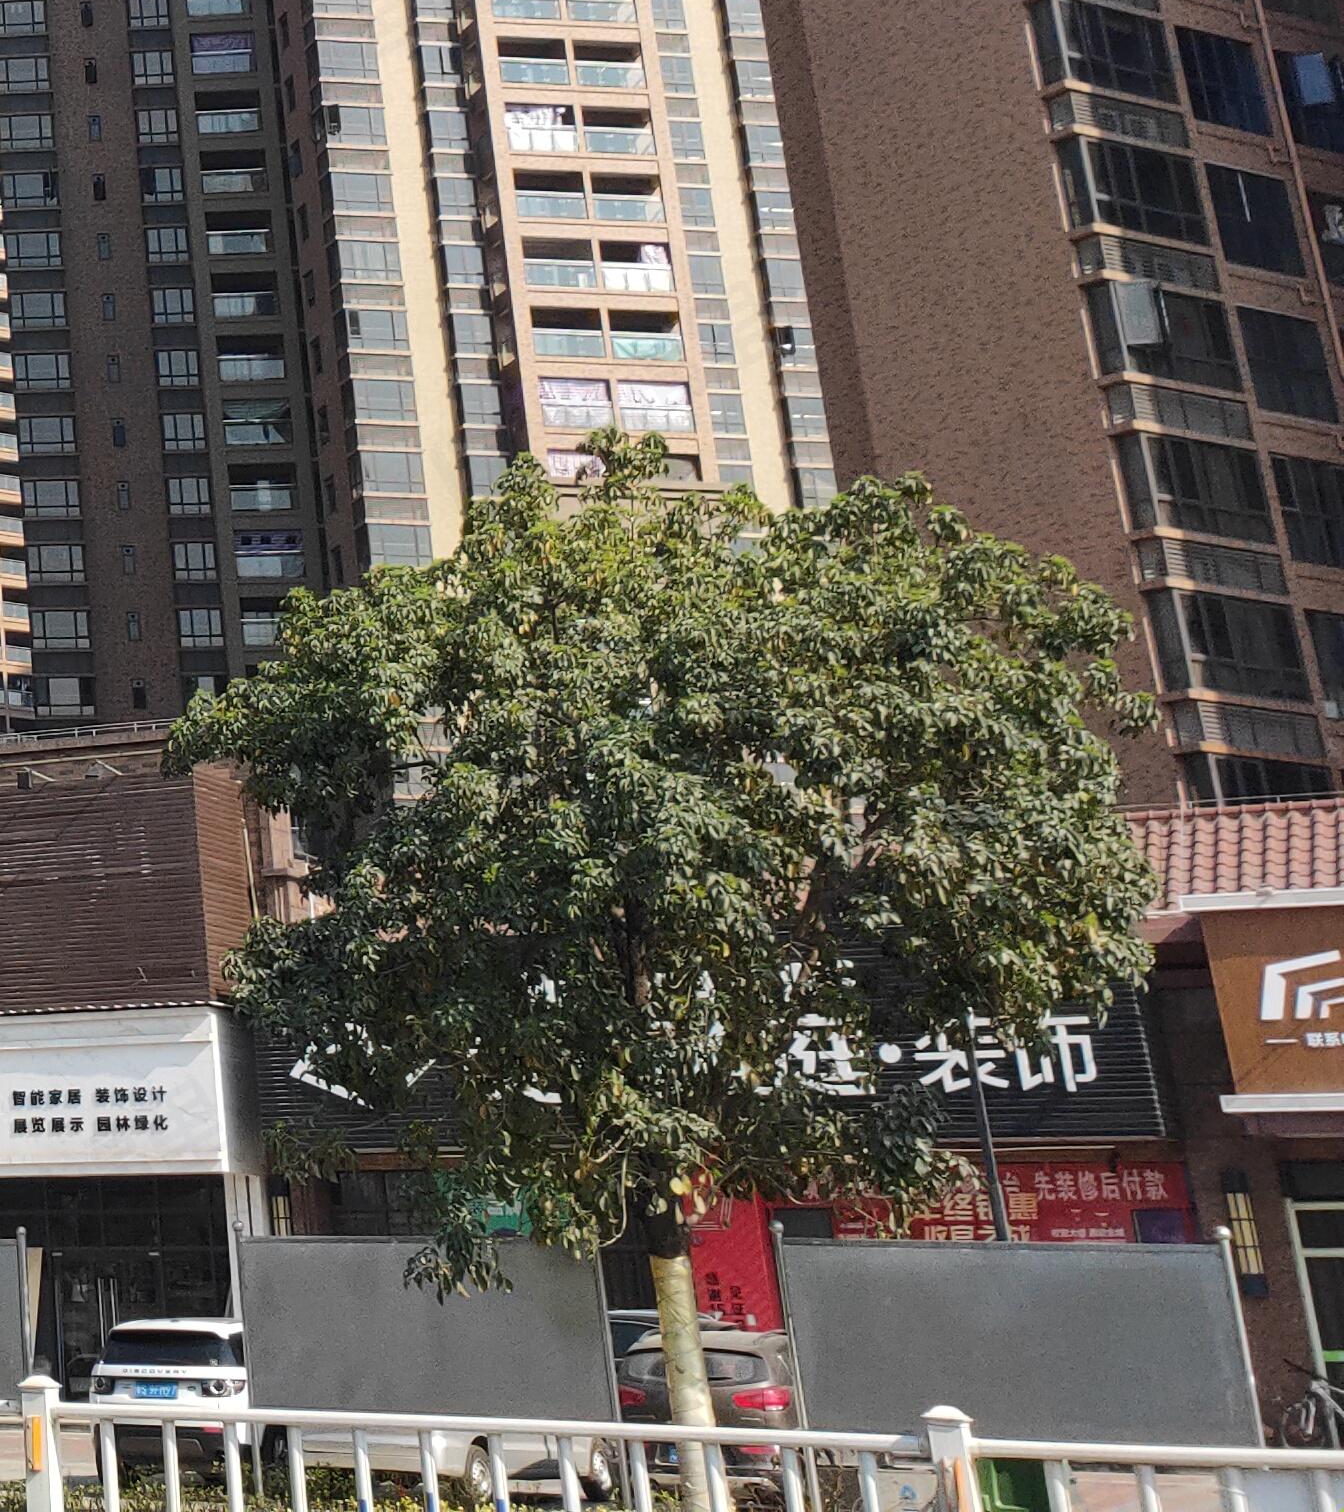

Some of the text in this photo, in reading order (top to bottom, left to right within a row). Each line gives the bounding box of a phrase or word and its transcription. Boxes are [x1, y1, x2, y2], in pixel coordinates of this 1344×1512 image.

[12, 1085, 167, 1106] 智能家居 装饰设计
[14, 1114, 168, 1134] 展览展示 园林绿化
[1034, 1169, 1168, 1201] 先装修后付款
